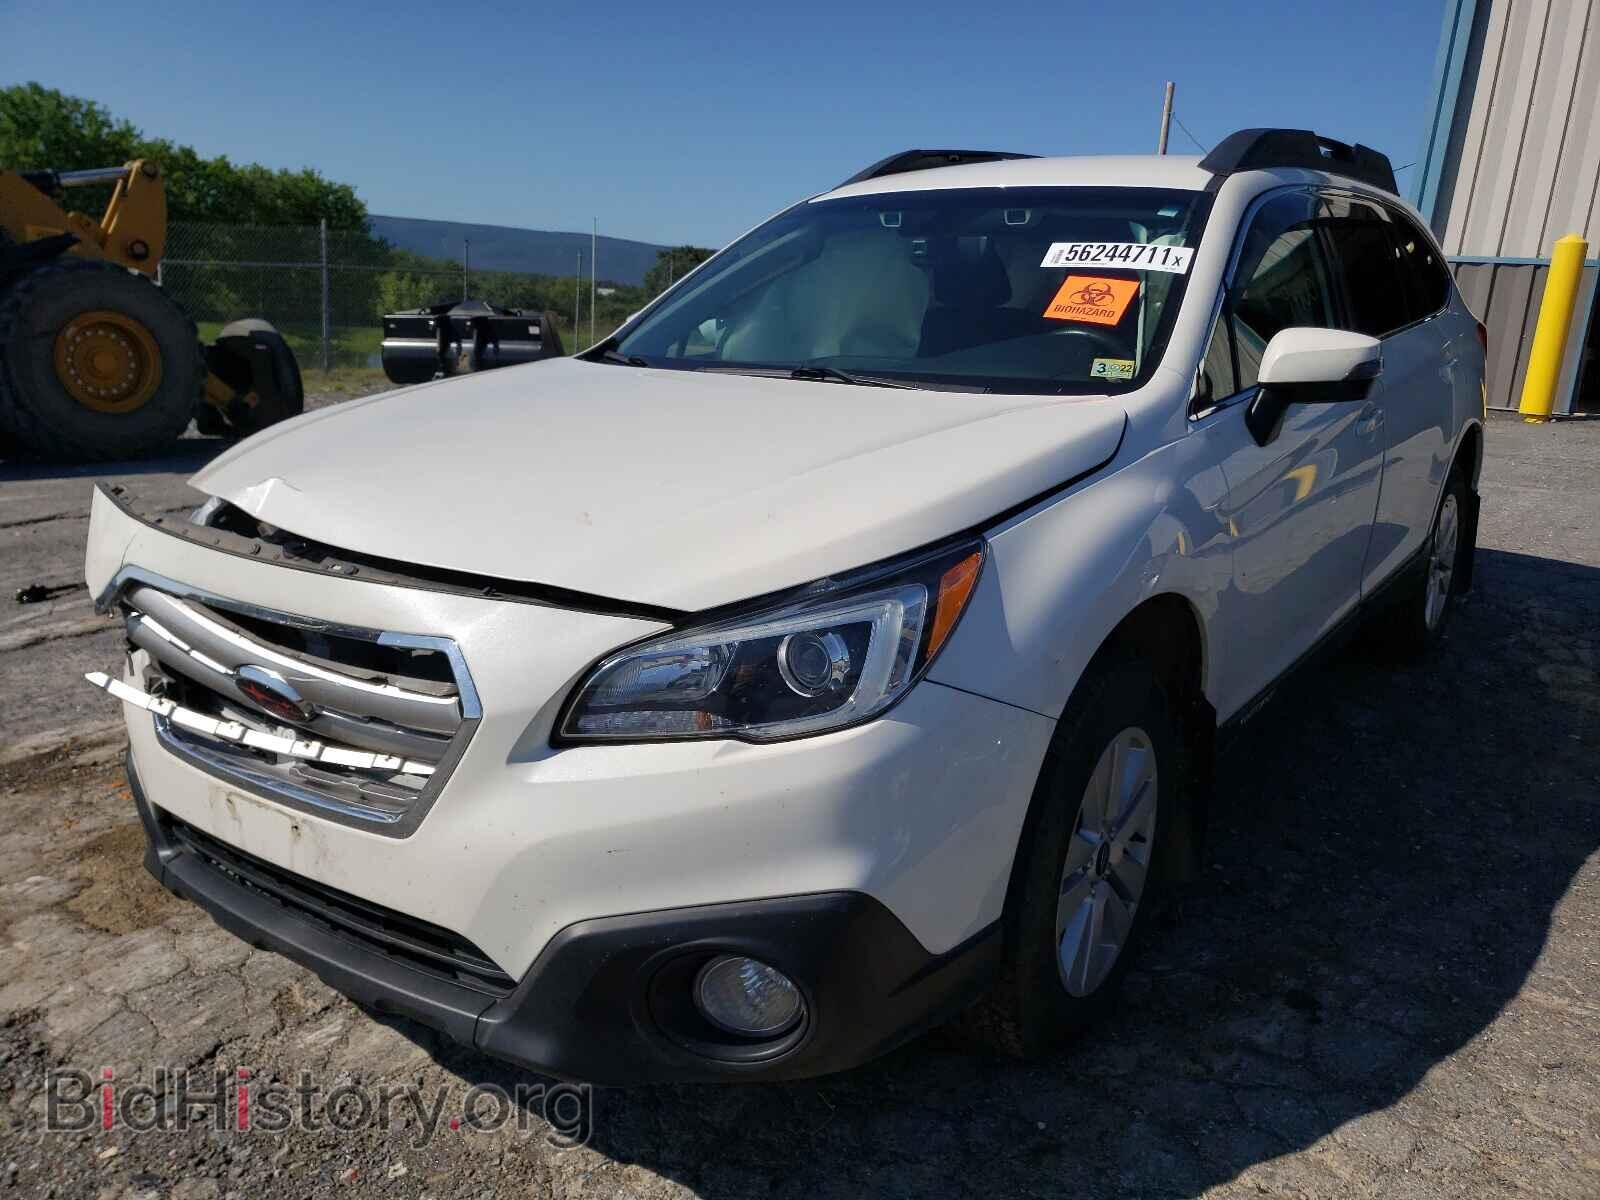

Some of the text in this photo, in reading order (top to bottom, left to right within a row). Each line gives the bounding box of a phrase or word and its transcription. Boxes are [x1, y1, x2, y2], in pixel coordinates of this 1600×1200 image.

[1065, 244, 1171, 265] 56244711
[1054, 304, 1116, 318] BIOHAZARD
[1097, 363, 1132, 373] 3 22
